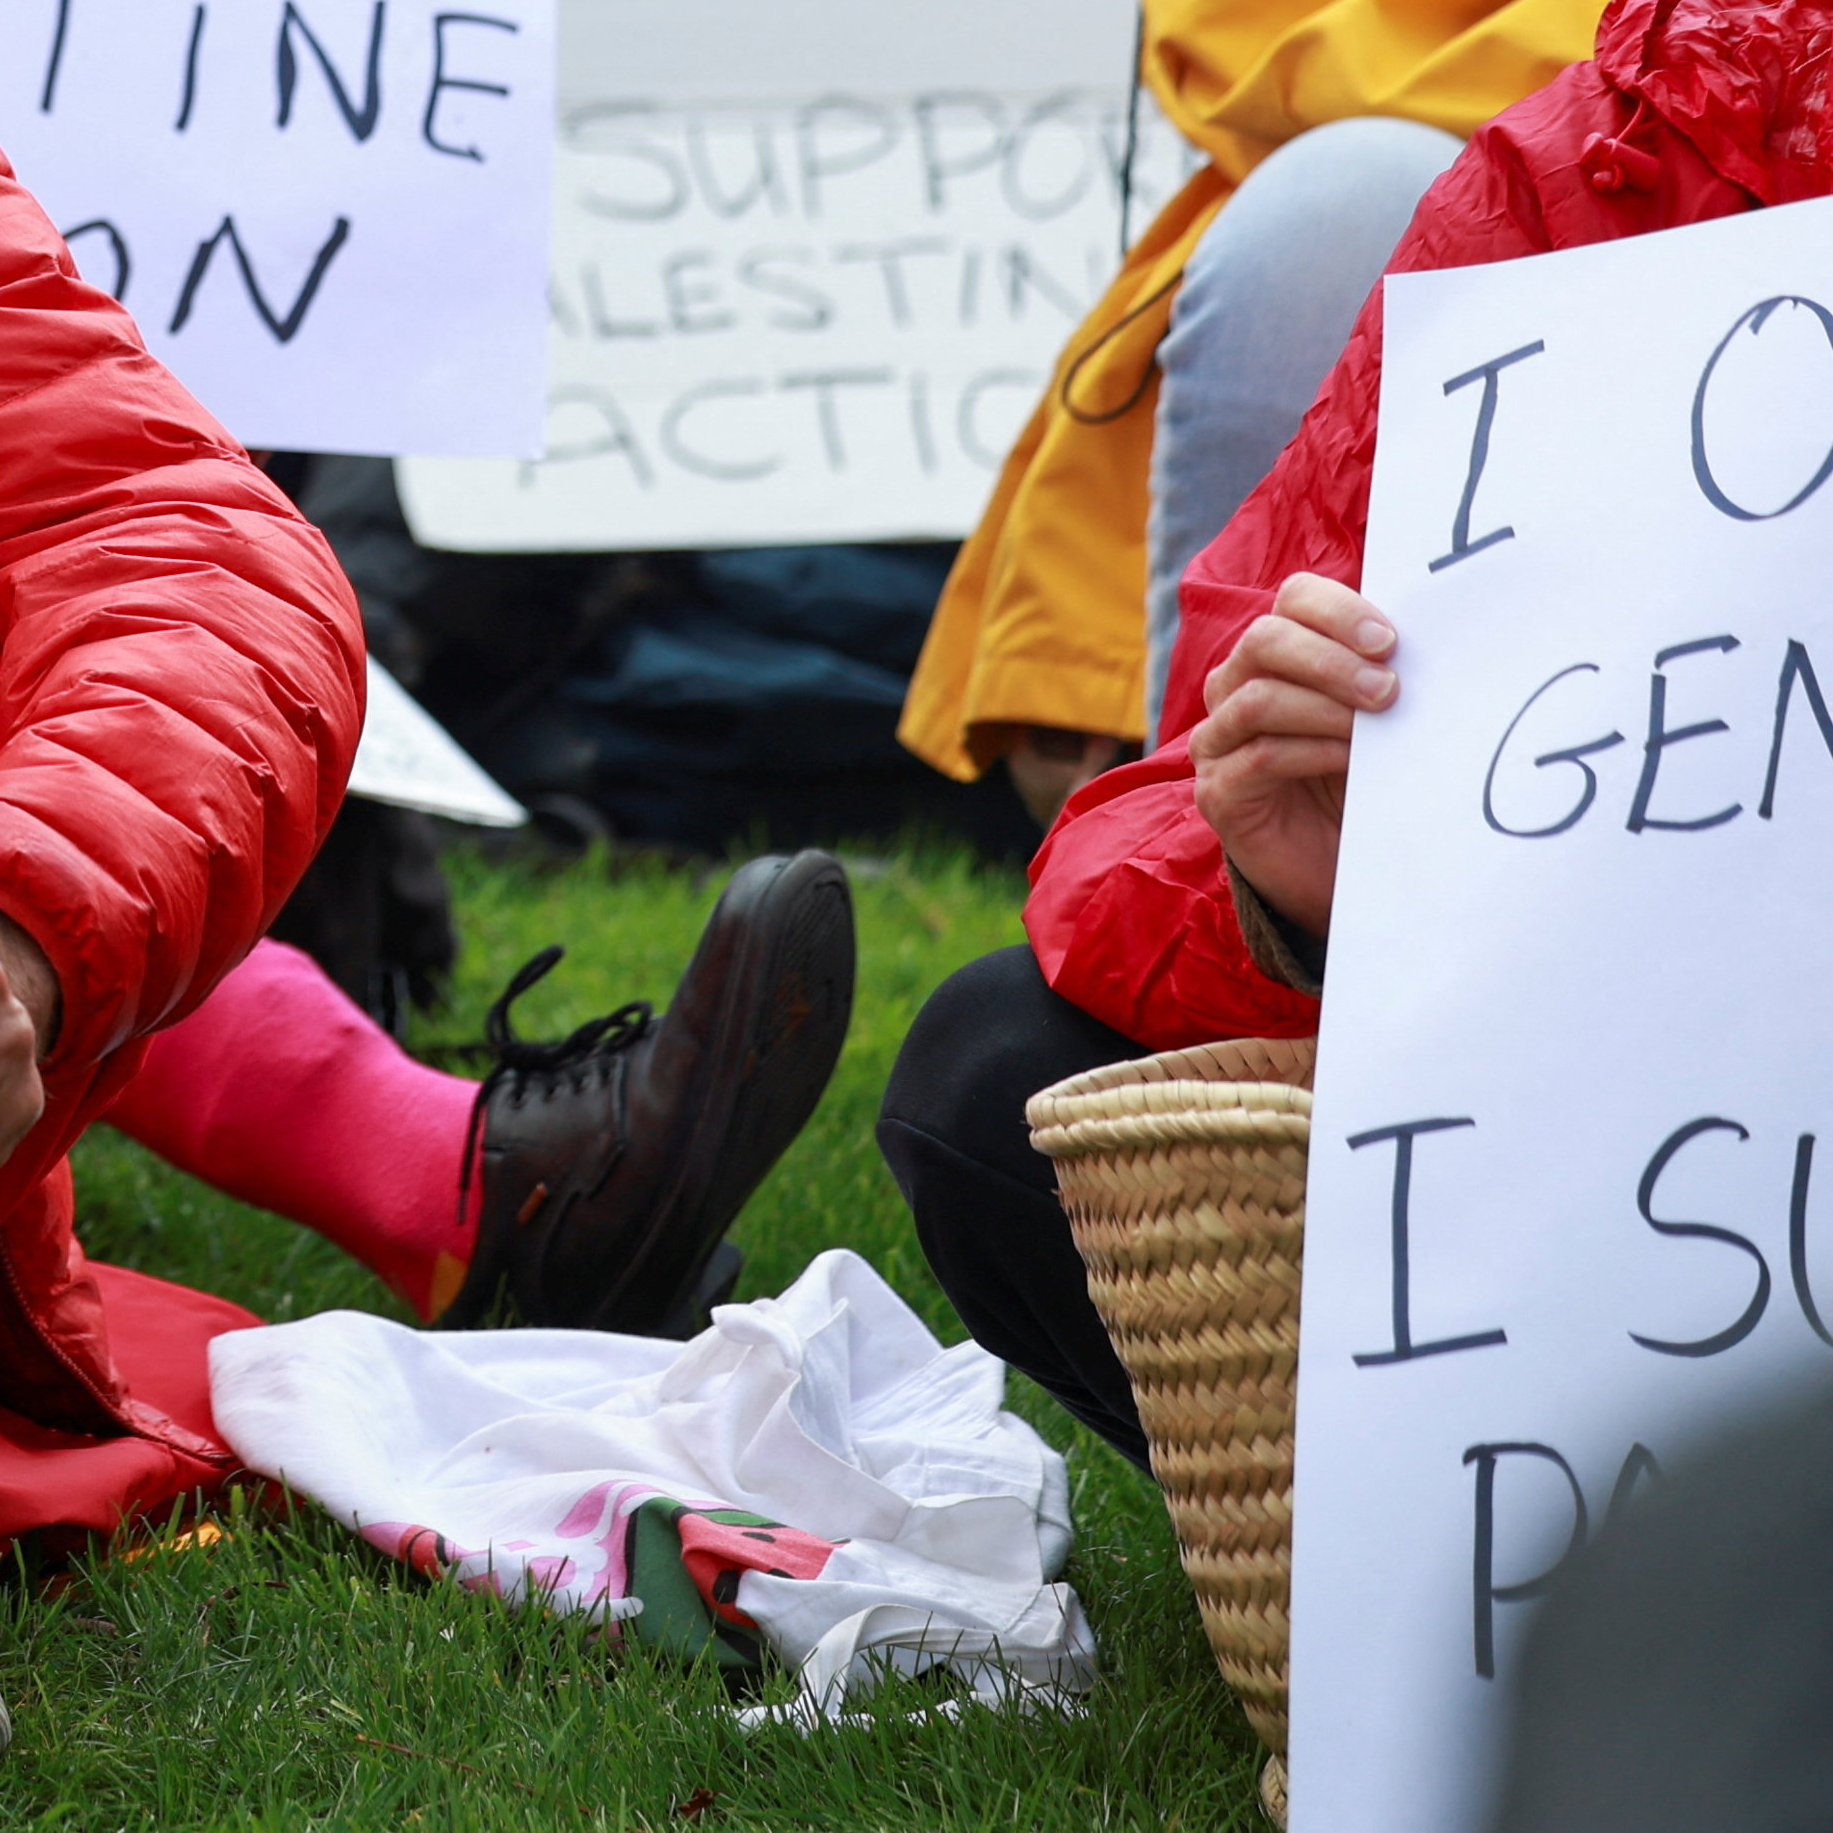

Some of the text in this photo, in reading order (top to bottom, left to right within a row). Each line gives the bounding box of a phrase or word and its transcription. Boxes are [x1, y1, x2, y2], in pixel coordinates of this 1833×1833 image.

[561, 88, 1203, 221] SUPPOR
[547, 234, 1105, 340] LESTIN
[1428, 338, 1546, 575] I
[1345, 1115, 1508, 1369] I
[1462, 1441, 1669, 1682] P
